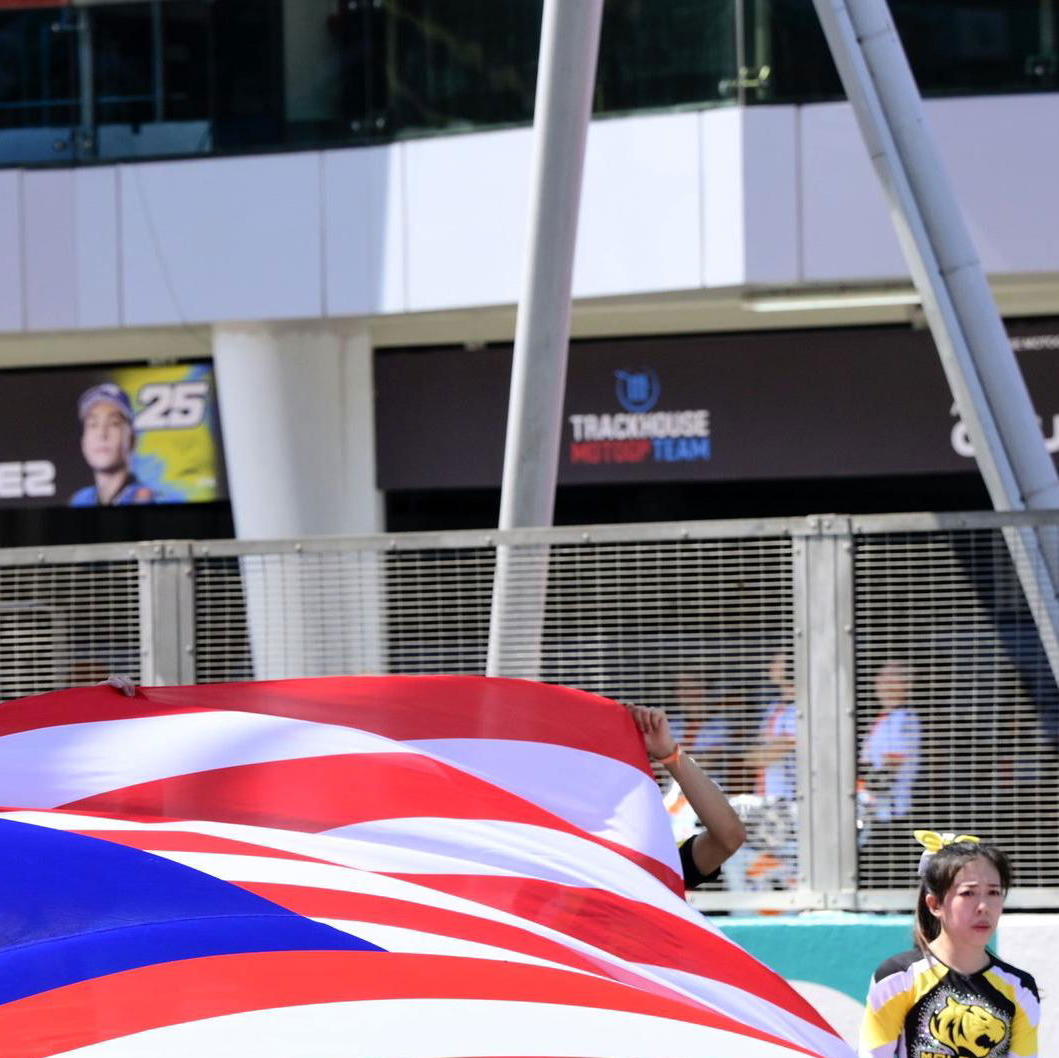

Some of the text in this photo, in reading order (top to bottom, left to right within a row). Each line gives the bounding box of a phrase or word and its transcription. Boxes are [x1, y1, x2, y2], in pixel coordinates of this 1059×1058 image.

[133, 382, 208, 430] 25
[569, 410, 710, 442] TRACKHOUSE
[653, 436, 711, 462] TEAM
